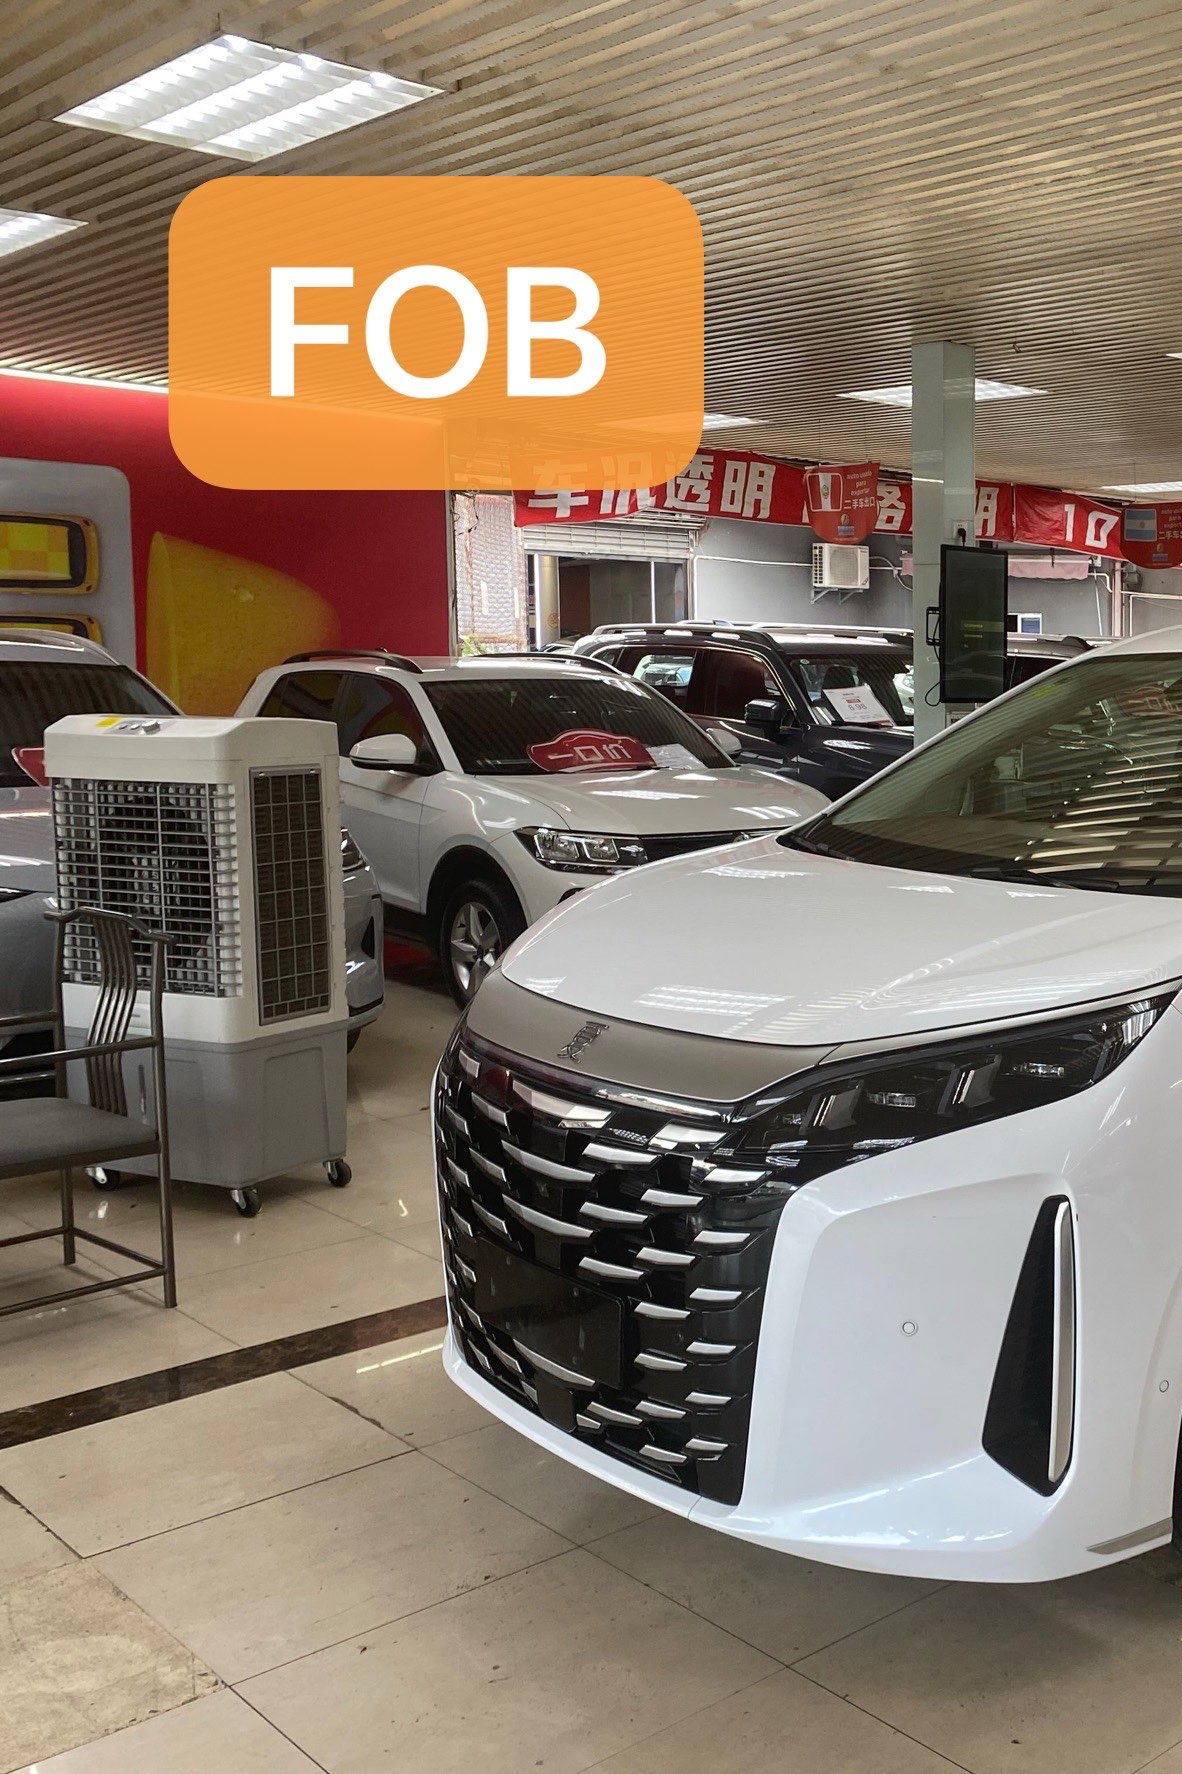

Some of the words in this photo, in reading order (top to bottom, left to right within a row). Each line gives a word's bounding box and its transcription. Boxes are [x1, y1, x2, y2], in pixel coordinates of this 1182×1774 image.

[844, 497, 876, 509] 二手车出口
